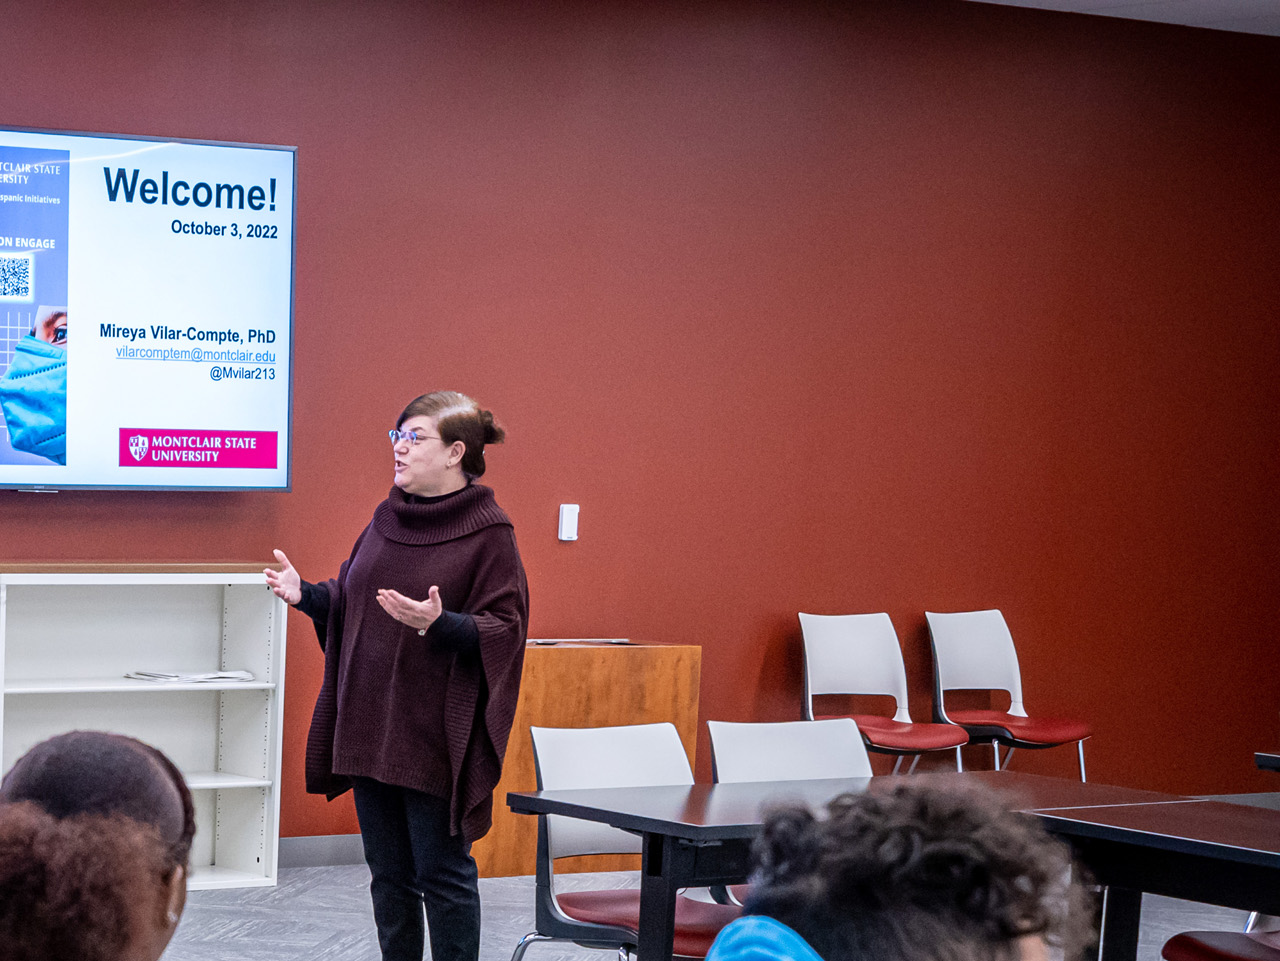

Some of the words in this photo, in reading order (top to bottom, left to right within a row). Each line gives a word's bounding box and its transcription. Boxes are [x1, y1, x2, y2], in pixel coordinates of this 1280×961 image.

[33, 163, 60, 175] STATE
[103, 167, 277, 211] Welcome!
[24, 194, 60, 204] Initiatives
[171, 220, 226, 236] October
[230, 224, 242, 239] 3,
[246, 225, 278, 239] 2022
[15, 238, 55, 249] ENGAGE
[99, 324, 146, 340] Mireya
[151, 325, 244, 345] Vilar-Compte,
[248, 330, 276, 344] PhD
[116, 345, 276, 363] vilarcomptem@montclair.edu
[210, 367, 276, 381] @Mvilar213
[152, 436, 222, 448] MONTCLAIR
[225, 438, 256, 448] STATE
[152, 450, 219, 462] UNIVERSITY
